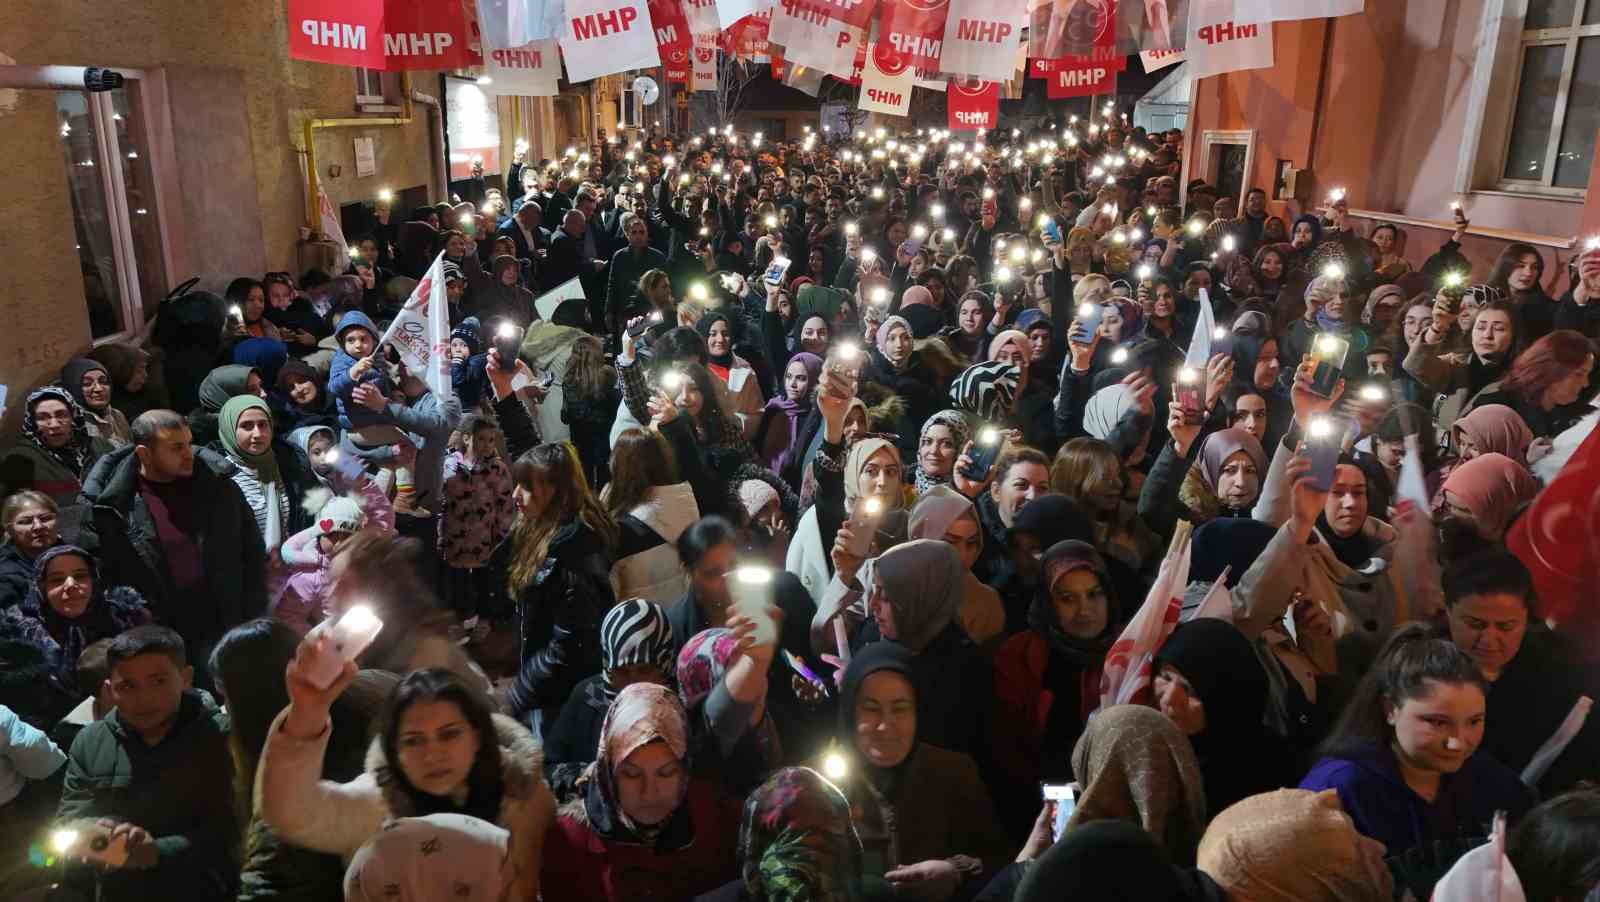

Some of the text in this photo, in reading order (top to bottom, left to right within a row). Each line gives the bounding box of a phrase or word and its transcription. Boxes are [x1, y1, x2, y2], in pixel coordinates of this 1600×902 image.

[571, 6, 637, 41] MHP
[956, 19, 1012, 44] MHP
[384, 32, 454, 56] MHP
[668, 71, 686, 80] MHP
[1060, 68, 1106, 88] MHP
